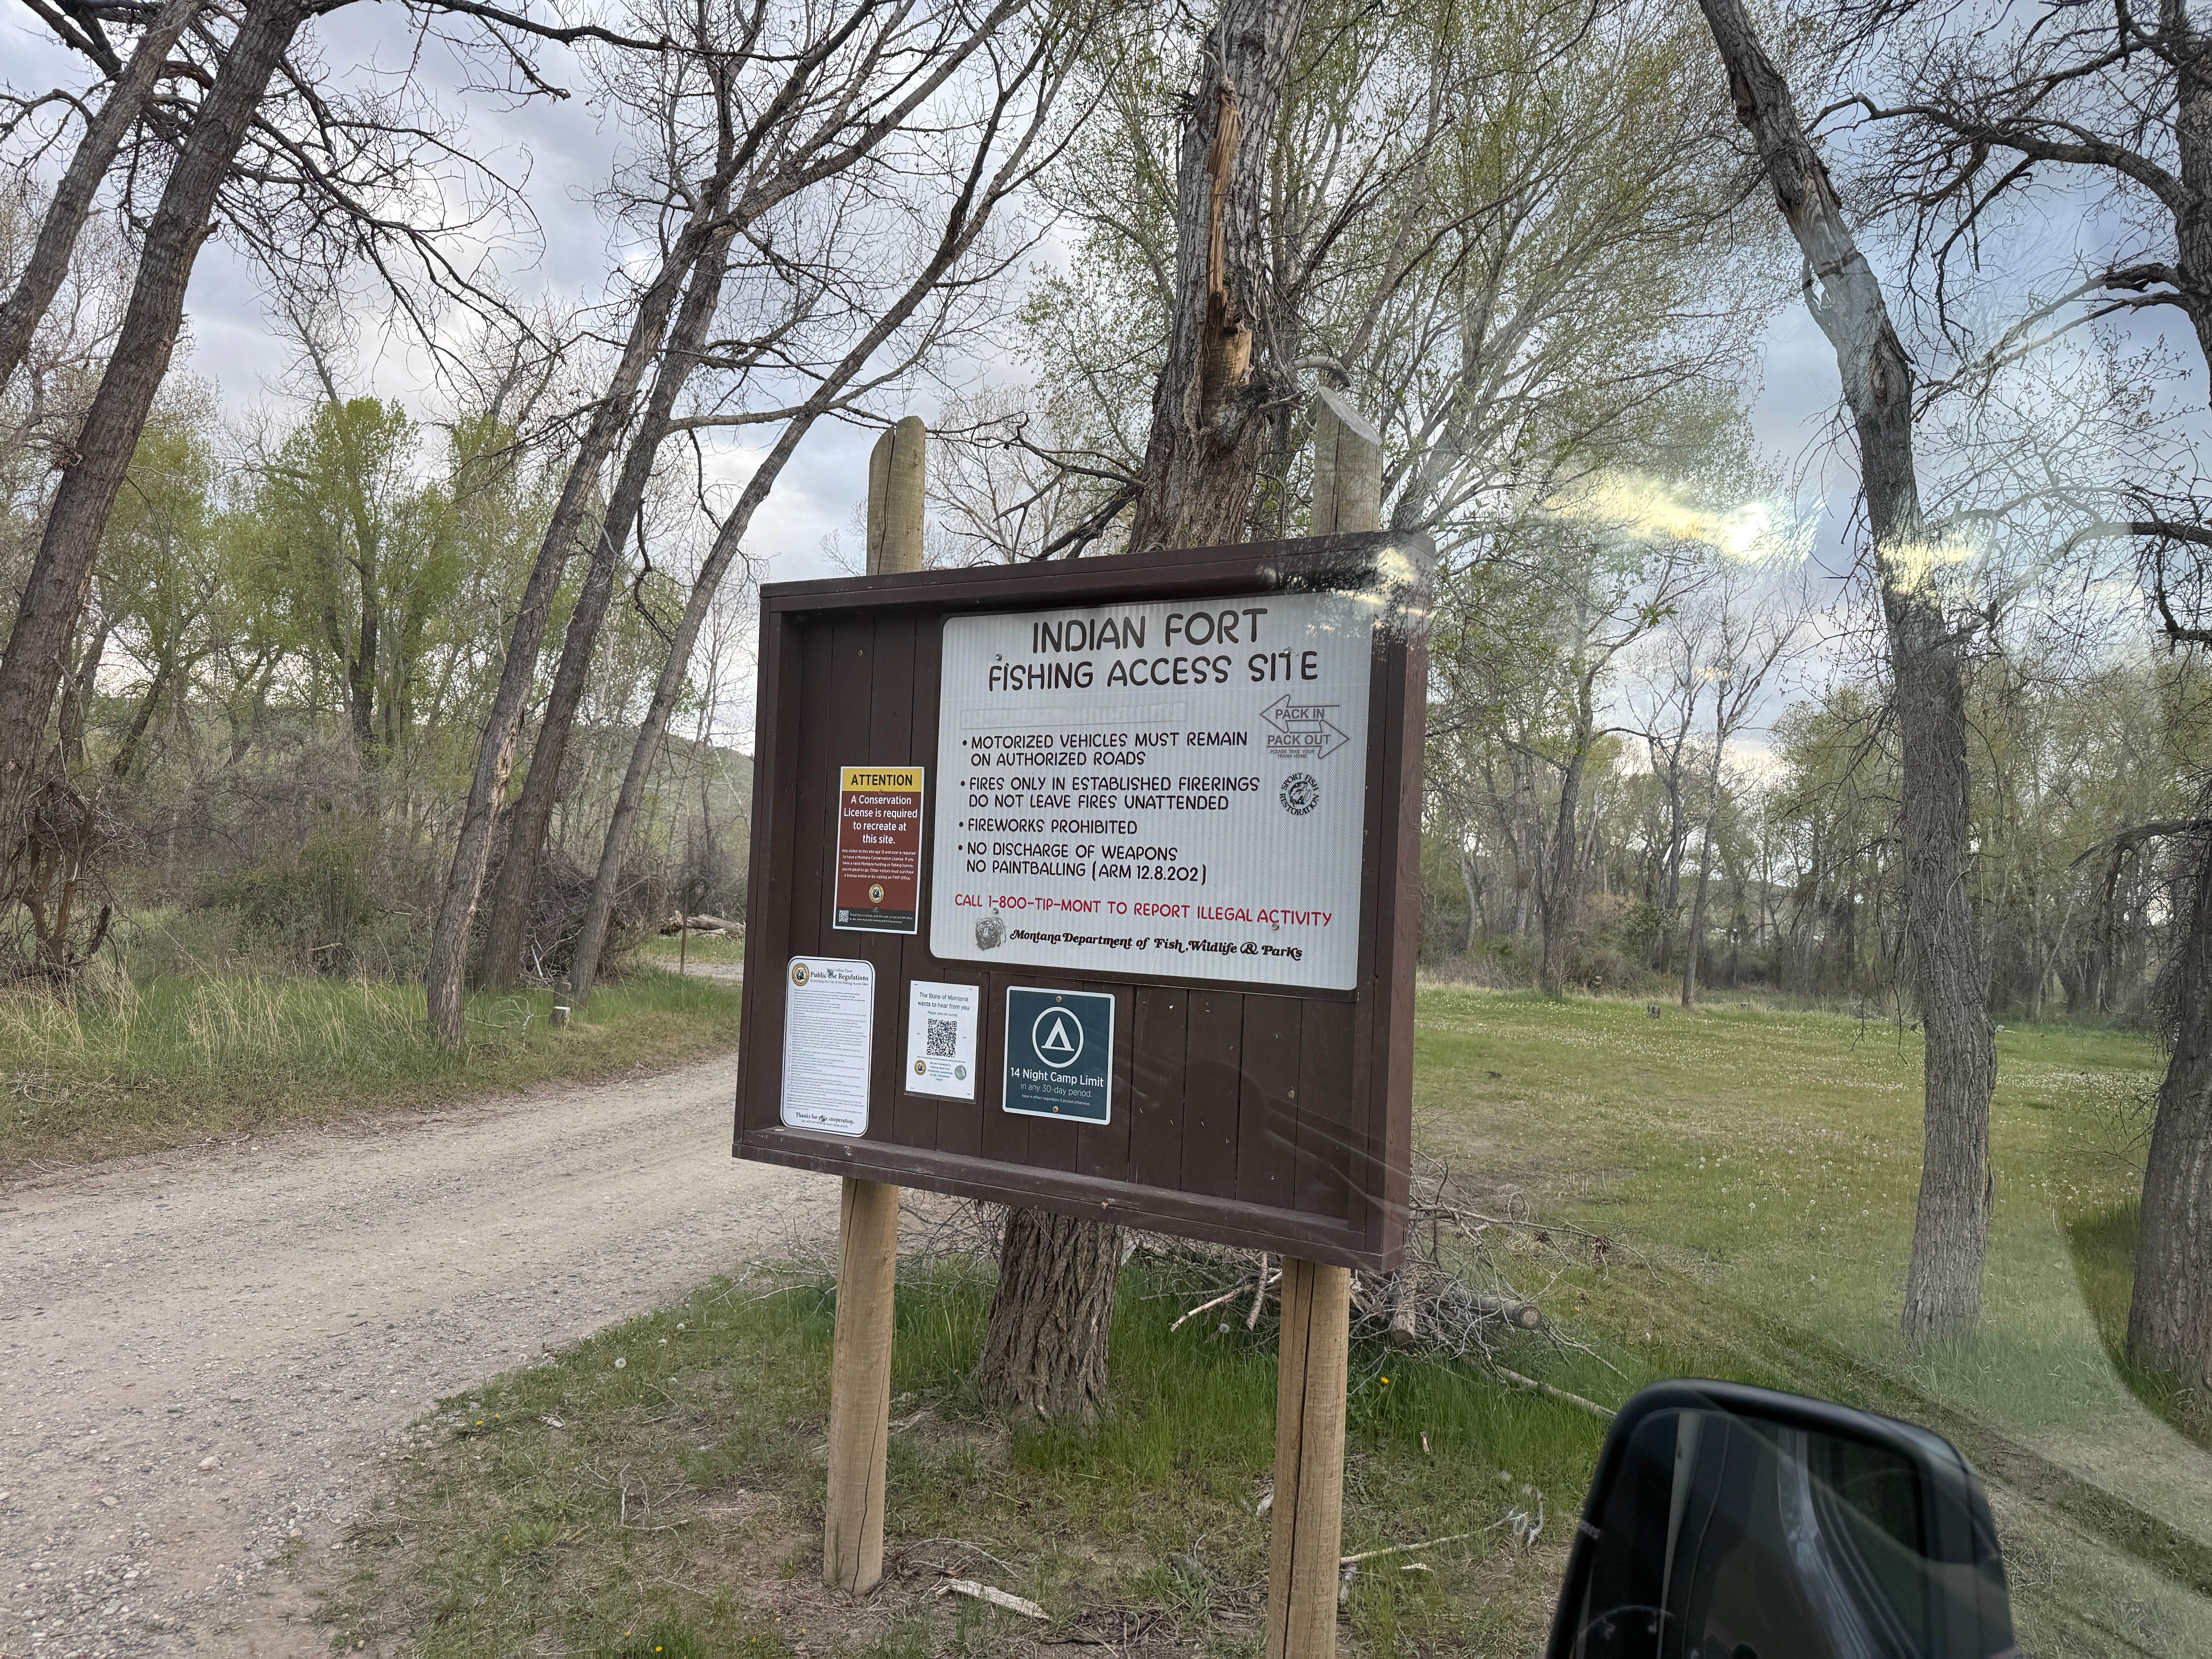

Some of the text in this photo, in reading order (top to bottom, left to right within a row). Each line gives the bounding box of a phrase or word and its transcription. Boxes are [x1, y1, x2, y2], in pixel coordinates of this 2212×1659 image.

[1033, 608, 1267, 653] INDIAN FORT
[989, 651, 1317, 691] FISHING ACCESS SITE
[1275, 708, 1324, 719] PACK IN
[971, 731, 1247, 749] MOTORIZED VEHICLES MUST REMAIN
[1267, 734, 1331, 745] PACK OUT
[971, 751, 1146, 766] ON AUTHORIZED ROADS
[851, 774, 912, 786] ATTENTION
[970, 776, 1260, 791] FIRES ONLY IN ESTABLISHED FIRERINGS
[1281, 773, 1319, 791] SPORT FISH
[851, 795, 911, 805] A Conservation
[969, 794, 1228, 810] DO NOT LEAVE FIRES UNATTENDED
[1279, 793, 1319, 816] RESTORATION
[844, 807, 917, 819] License is required
[853, 821, 906, 831] to recreate at
[968, 818, 1137, 834] FIREWORKS PROHIBITED
[863, 834, 895, 844] this site.
[968, 842, 1178, 861] NO DISCHARGE OF WEAPONS
[967, 859, 1206, 885] NO PAINTBALLING (ARM 12.8.202)
[955, 893, 1332, 927] CALL 1-800-TIP-MONT TO REPORT ILLEGAL ACTIVITY
[1010, 929, 1061, 945] Montana
[1062, 933, 1133, 949] Department
[1136, 937, 1150, 950] of
[1240, 942, 1259, 955] &
[1261, 945, 1302, 961] Parks
[838, 973, 868, 981] Regulations
[1010, 1067, 1104, 1087] 14 Night Camp Limit
[1020, 1082, 1092, 1097] in any 30-day period.
